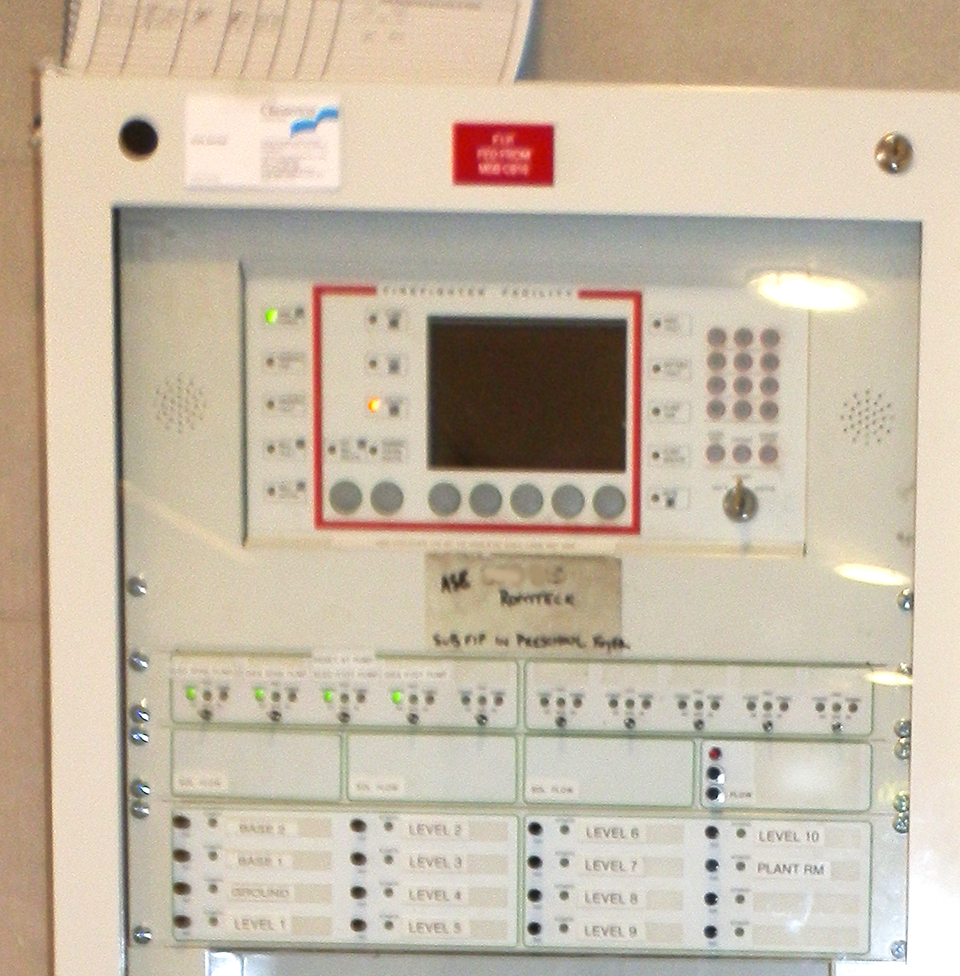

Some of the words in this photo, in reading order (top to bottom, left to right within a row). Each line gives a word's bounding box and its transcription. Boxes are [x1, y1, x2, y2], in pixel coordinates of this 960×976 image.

[408, 824, 450, 836] LEVEL
[586, 827, 626, 839] LEVEL
[630, 828, 640, 839] 6
[759, 831, 800, 842] LEVEL
[806, 830, 819, 842] 10
[409, 856, 450, 868] LEVEL
[453, 857, 462, 869] 3
[585, 859, 626, 872] LEVEL
[630, 860, 638, 872] 7
[757, 862, 799, 875] PLANT
[803, 863, 825, 875] RM
[408, 889, 450, 901] LEVEL
[454, 890, 462, 901] 4
[584, 891, 626, 905] LEVEL
[629, 893, 638, 905] 8
[234, 918, 275, 931] LEVEL
[408, 921, 449, 934] LEVEL
[453, 922, 462, 934] 5
[584, 925, 625, 938] LEVEL
[628, 926, 638, 938] 9
